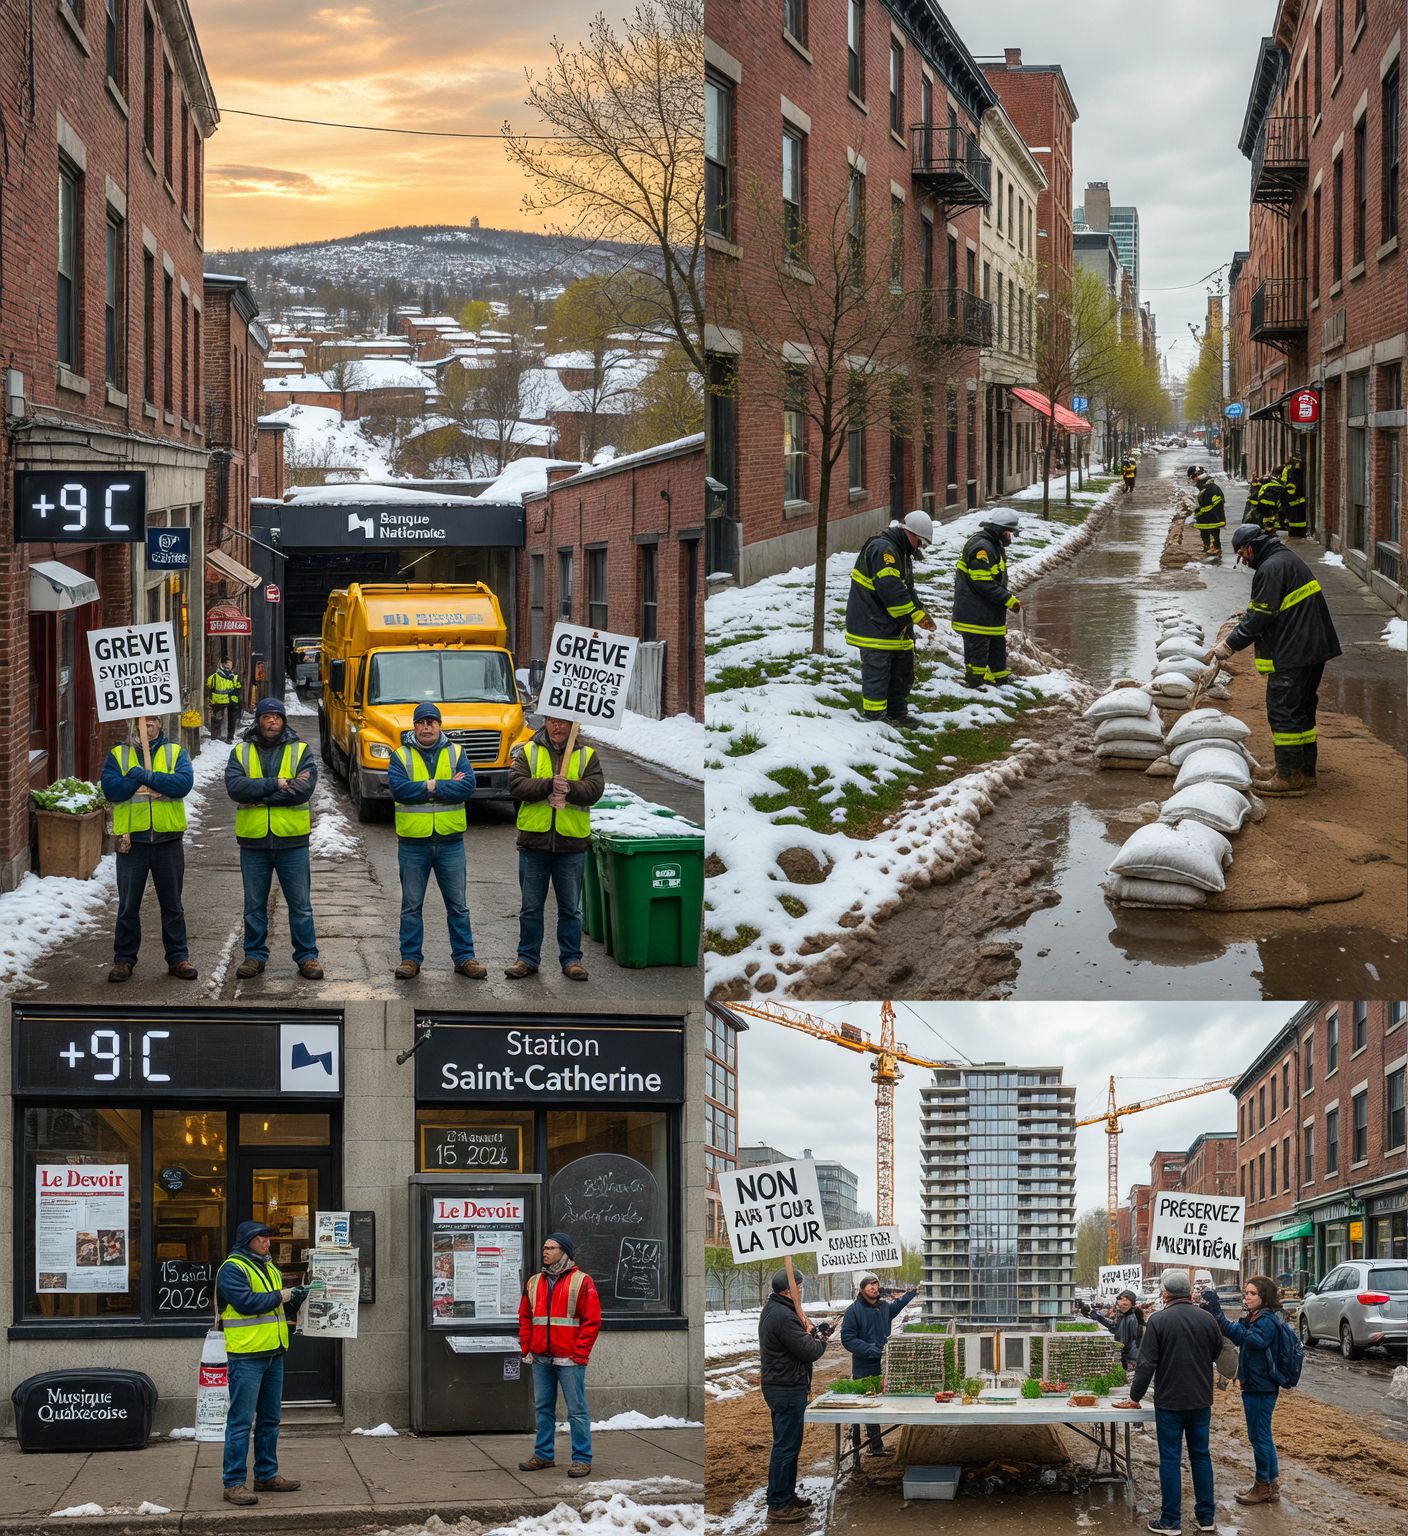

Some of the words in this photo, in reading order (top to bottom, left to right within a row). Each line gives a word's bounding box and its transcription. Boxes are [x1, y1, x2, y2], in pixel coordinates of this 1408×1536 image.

[380, 512, 429, 527] Banque
[99, 658, 171, 680] SYNDICAT
[552, 660, 625, 687] SYNDICAT
[104, 683, 173, 711] BLEUS
[548, 686, 616, 719] BLEUS
[507, 1030, 599, 1056] Station
[441, 1063, 662, 1092] Saint-Catherine
[436, 1144, 457, 1165] 15
[41, 1170, 63, 1187] Le
[67, 1169, 124, 1187] Devoir
[735, 1167, 799, 1204] NON
[439, 1201, 460, 1219] Le
[463, 1201, 521, 1219] Devoir
[1160, 1198, 1241, 1223] PRÉSERVEZ
[736, 1231, 765, 1254] LA
[767, 1220, 822, 1249] TOUR
[160, 1260, 181, 1283] 15
[158, 1286, 210, 1310] 2026
